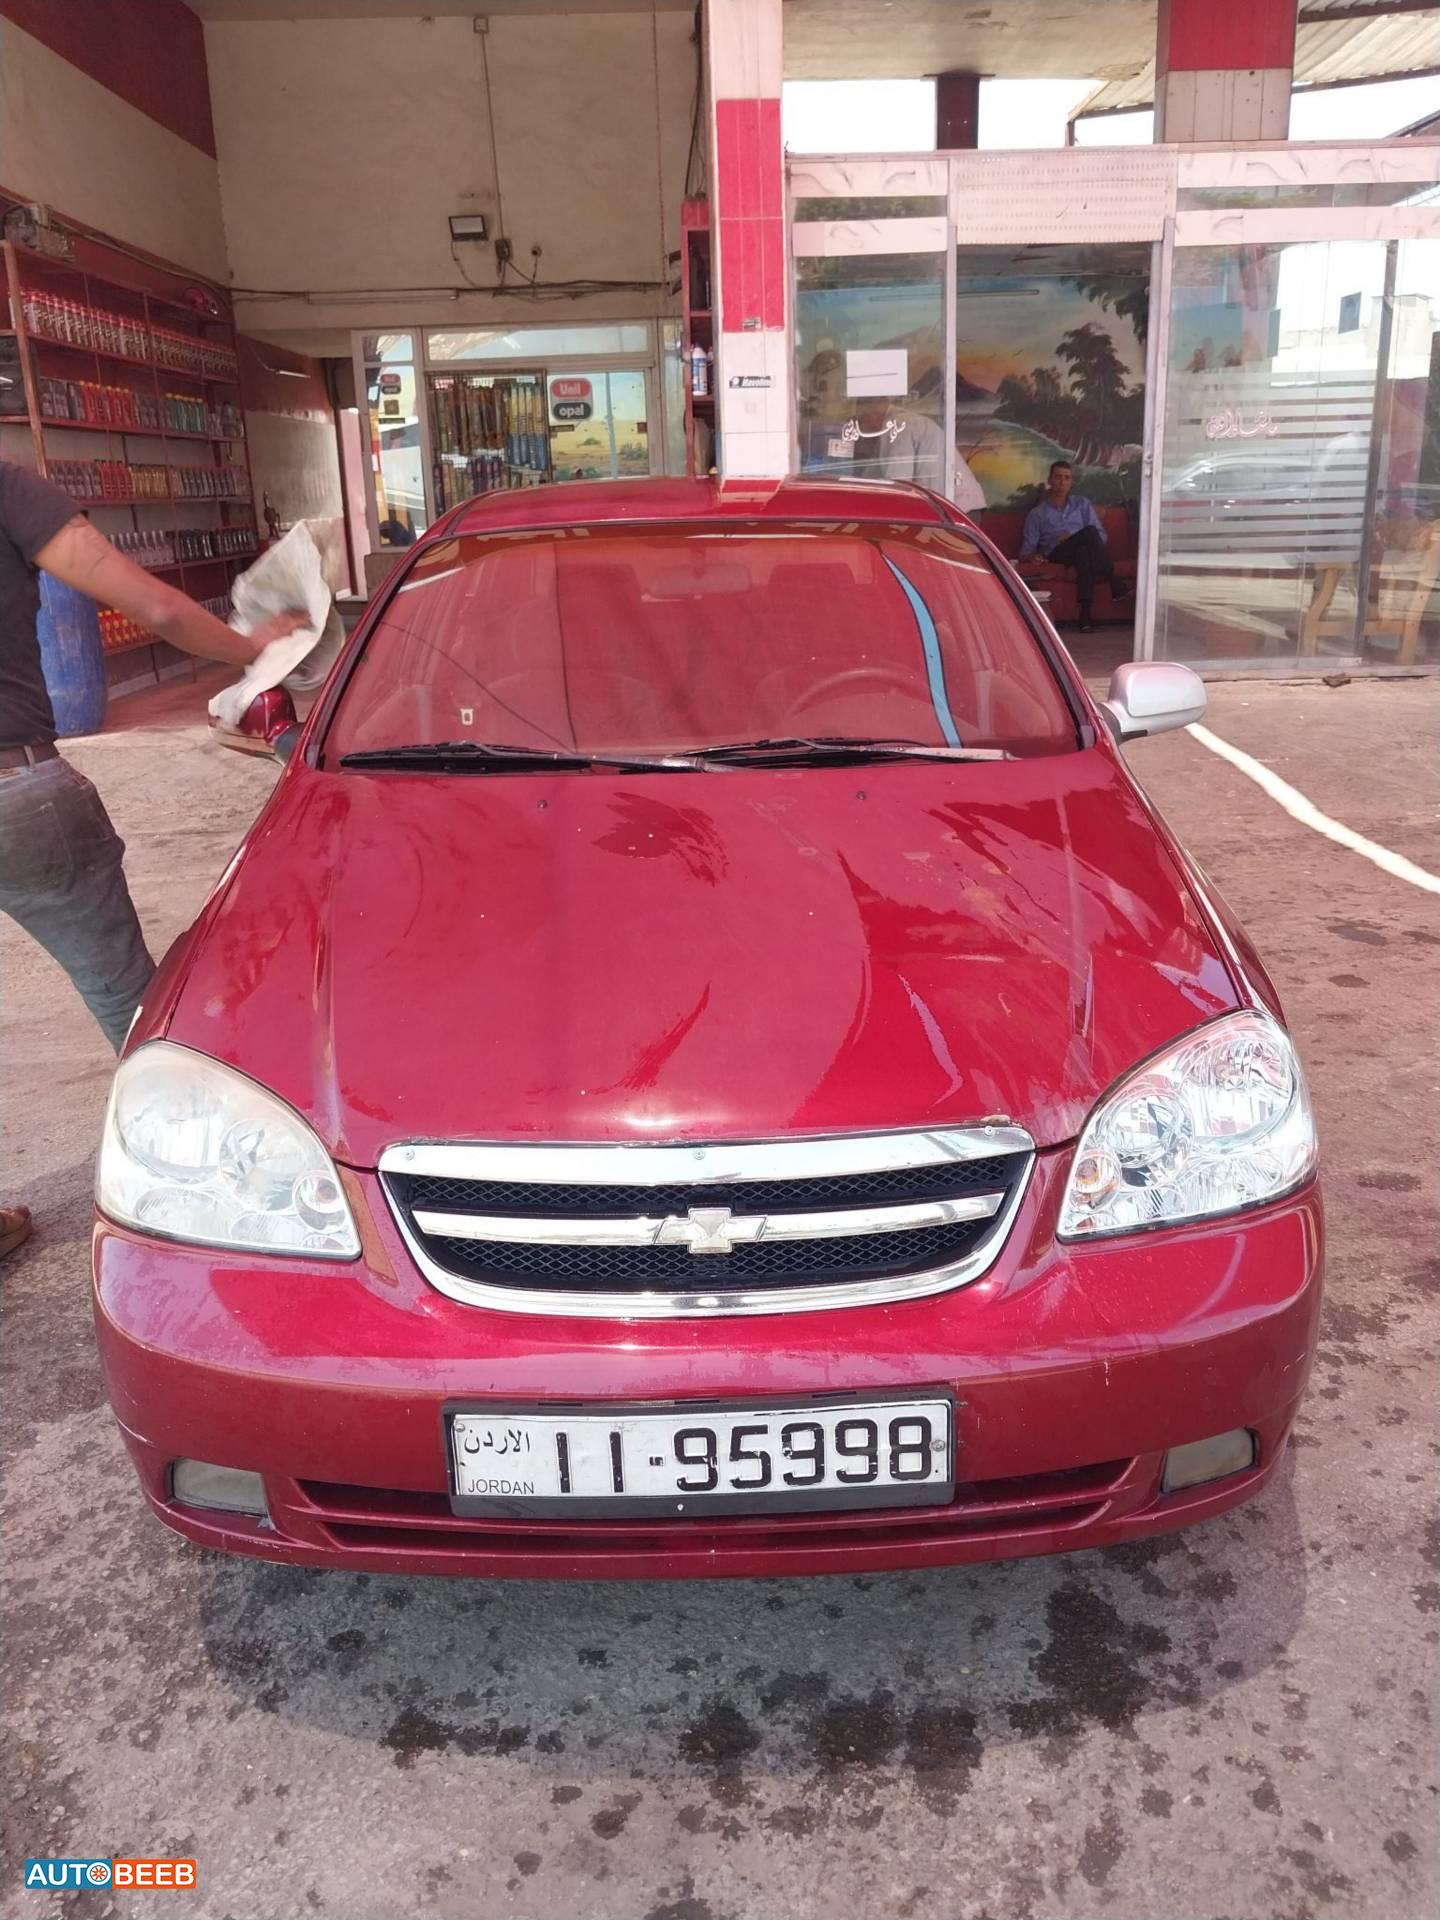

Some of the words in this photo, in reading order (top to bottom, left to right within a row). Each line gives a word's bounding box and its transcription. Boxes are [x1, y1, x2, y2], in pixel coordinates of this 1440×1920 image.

[559, 404, 585, 418] opal
[463, 1428, 531, 1455] الاردن
[467, 1478, 535, 1495] JORDAN
